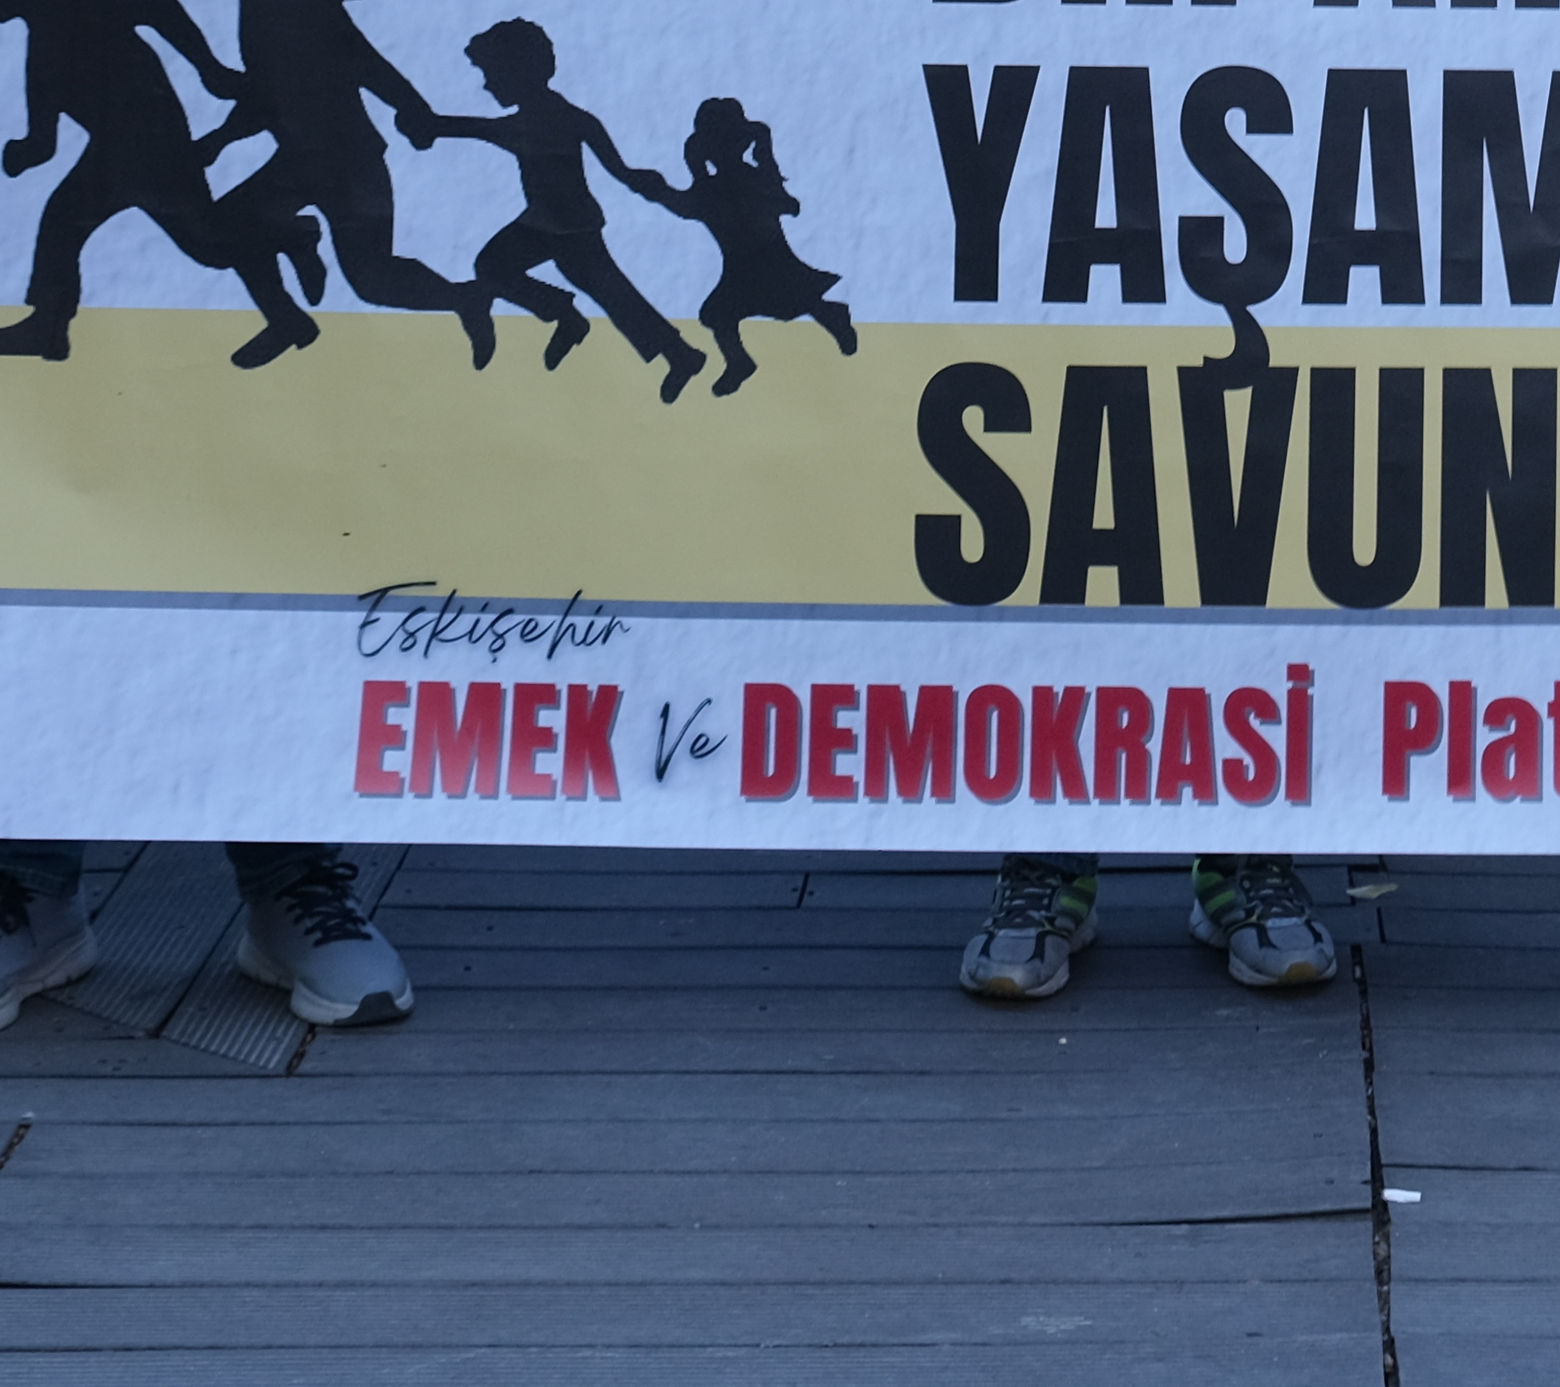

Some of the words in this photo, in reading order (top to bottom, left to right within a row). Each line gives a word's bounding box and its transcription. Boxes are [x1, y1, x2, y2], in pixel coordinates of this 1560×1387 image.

[354, 580, 631, 664] Eskişehir
[353, 679, 621, 801] EMEK
[653, 697, 728, 783] Ve
[739, 663, 1313, 806] DEMOKRASİ
